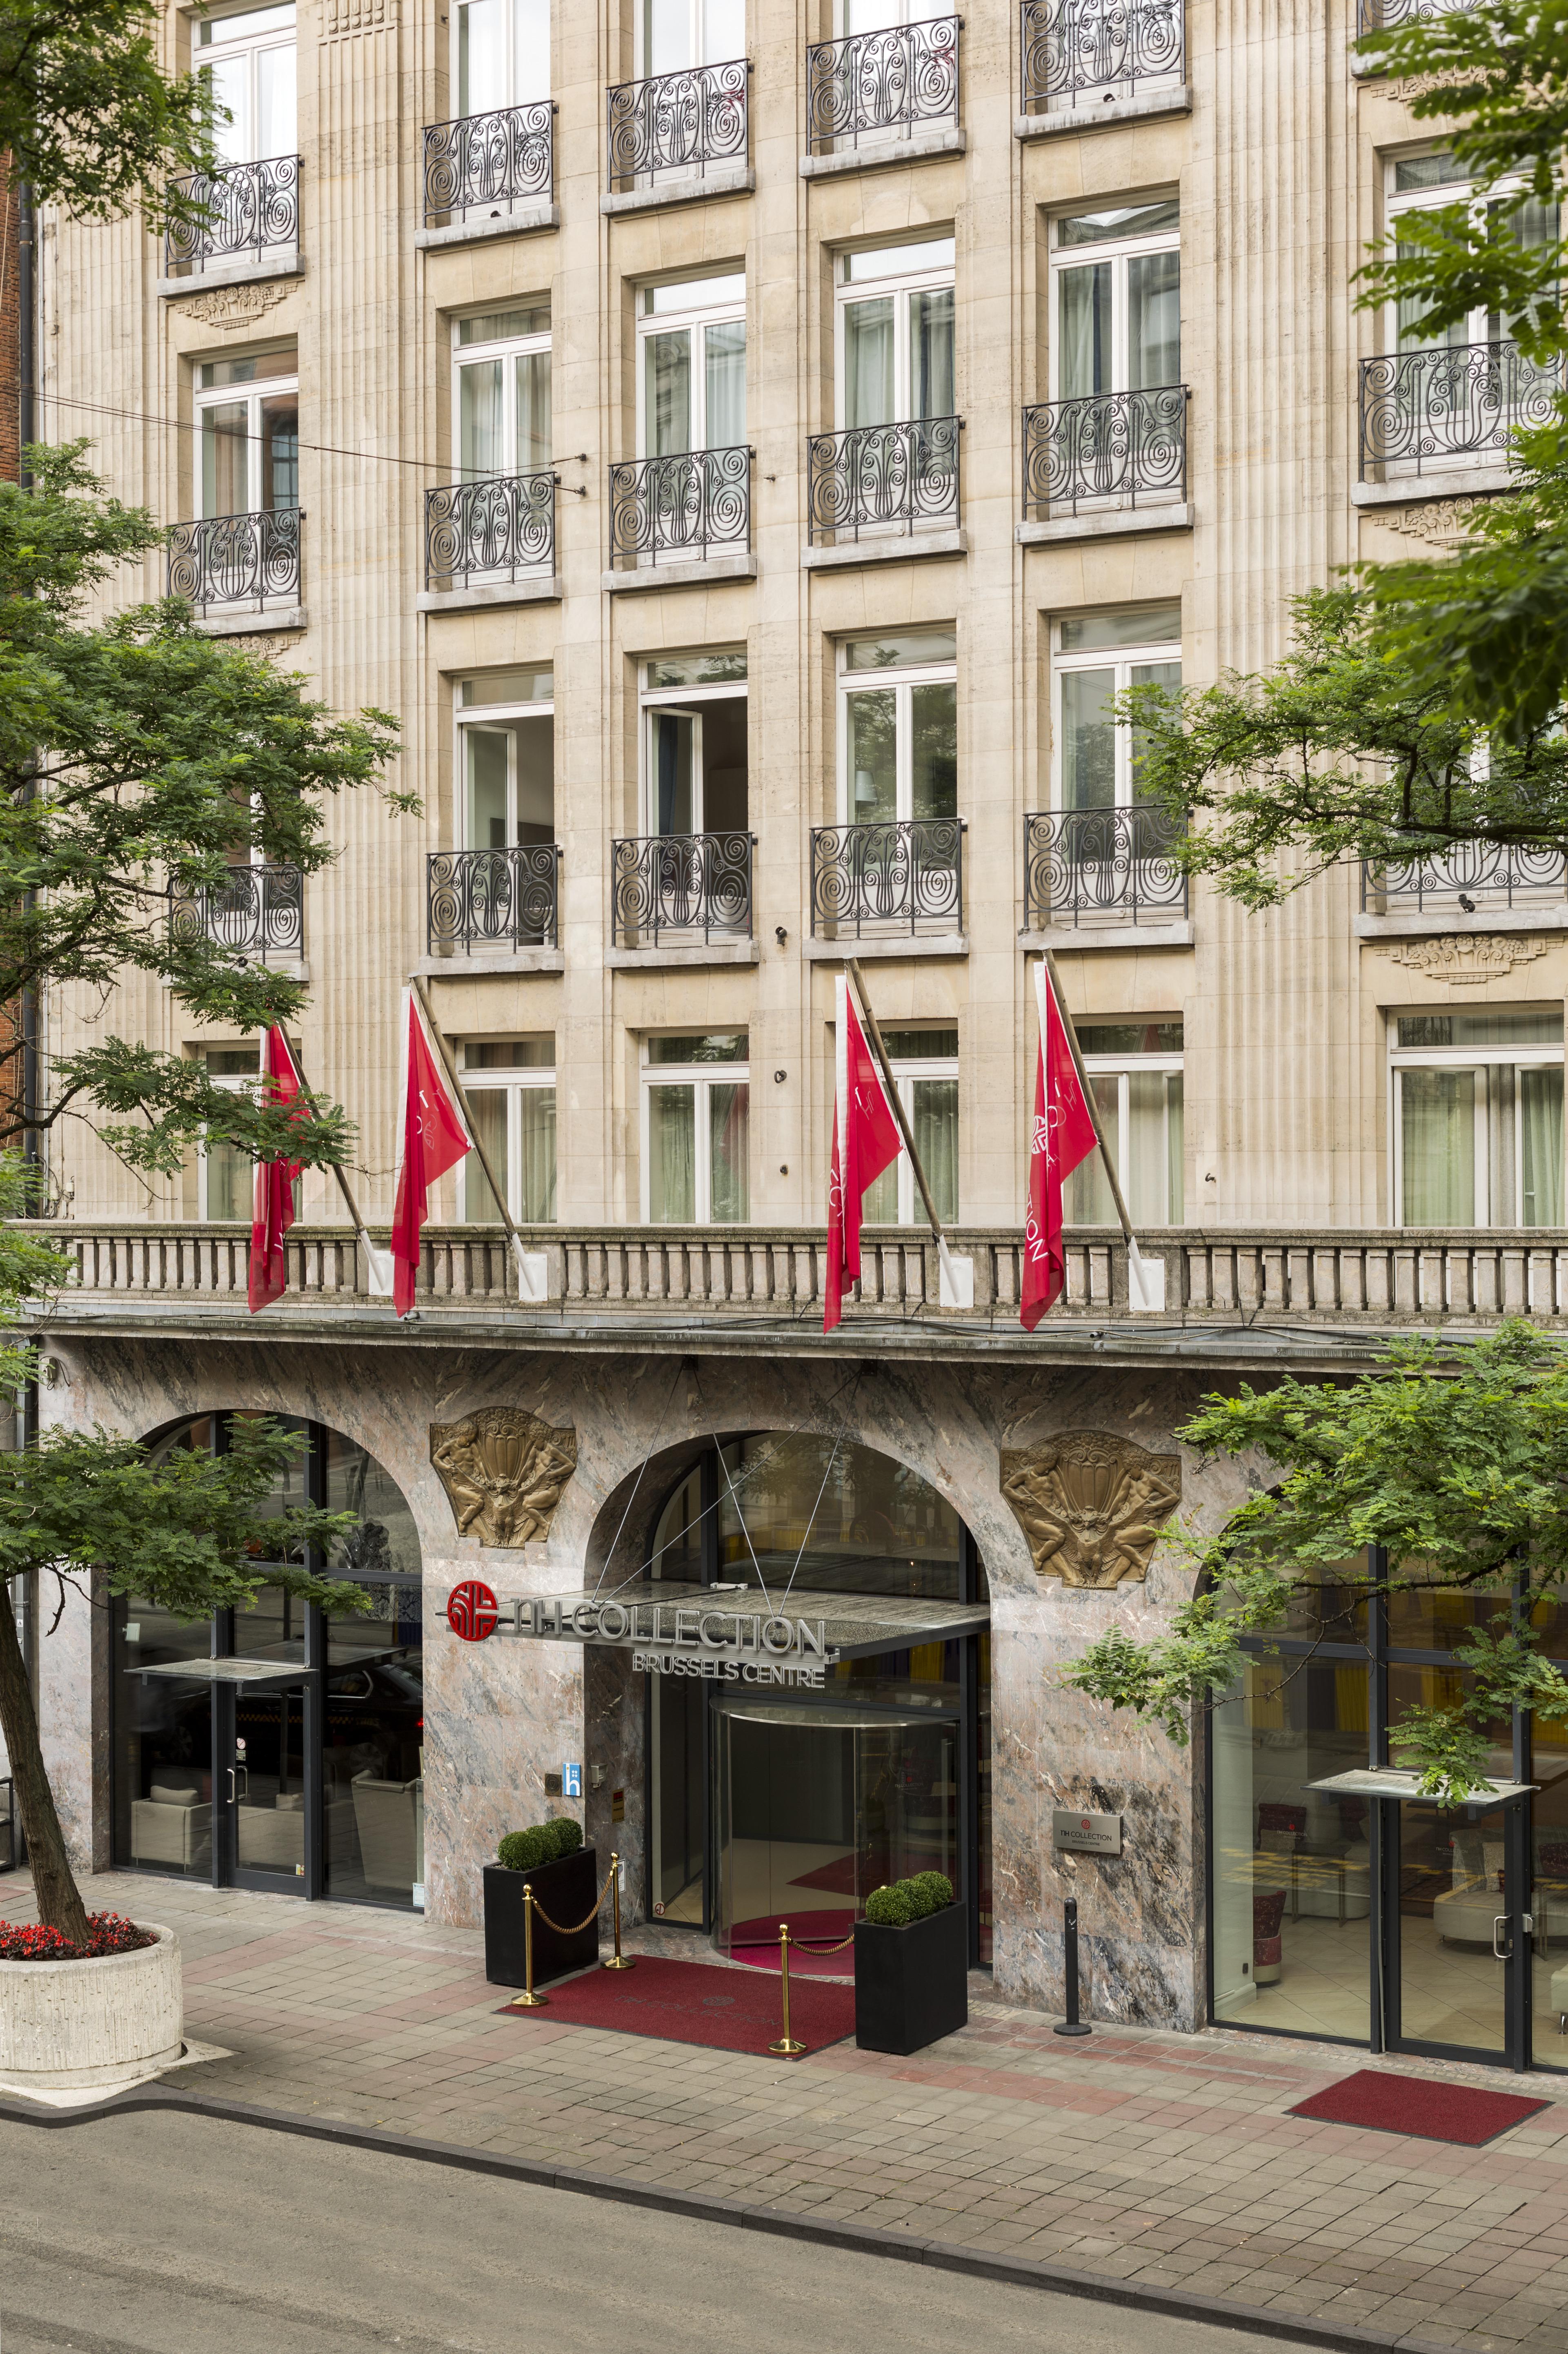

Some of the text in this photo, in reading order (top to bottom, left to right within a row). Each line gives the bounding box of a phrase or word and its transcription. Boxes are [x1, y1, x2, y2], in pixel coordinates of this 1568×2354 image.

[572, 1601, 825, 1657] COLLECTION
[632, 1653, 825, 1688] BRUSSELS CENTRE
[1071, 1831, 1112, 1841] COLLECTION
